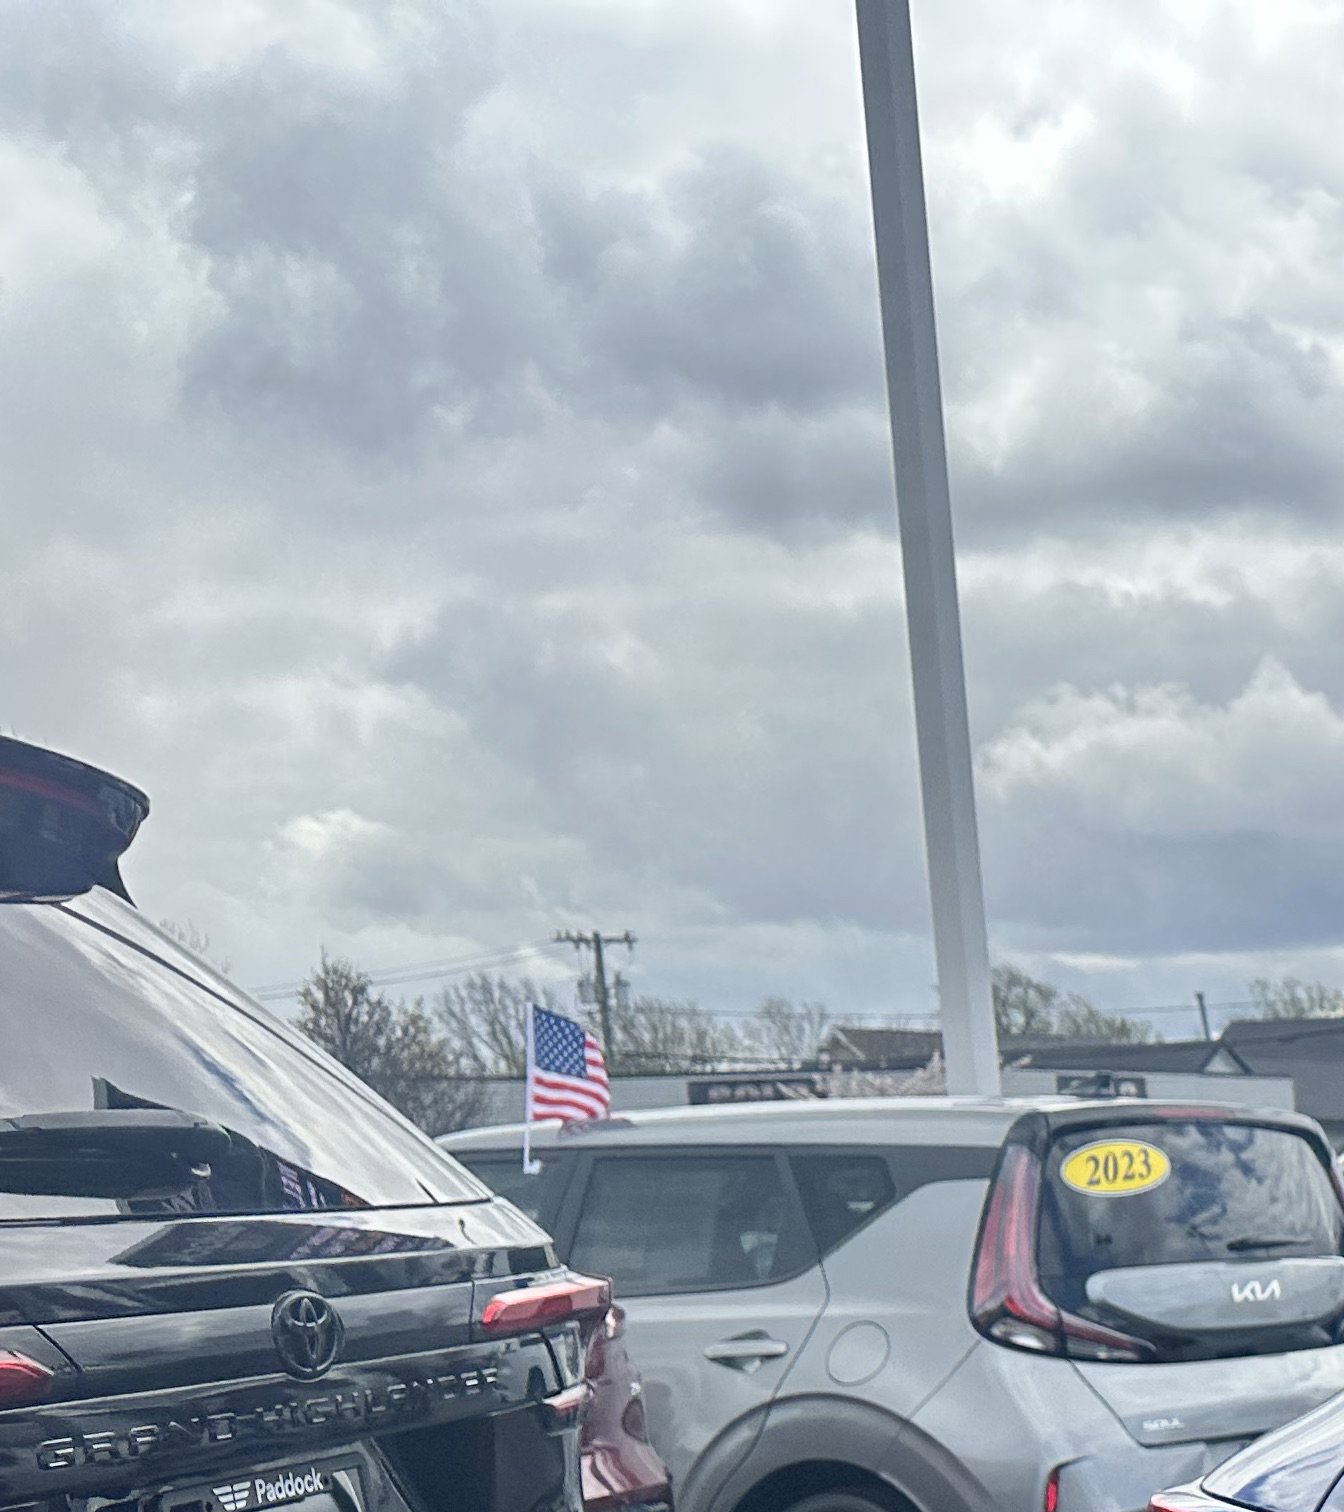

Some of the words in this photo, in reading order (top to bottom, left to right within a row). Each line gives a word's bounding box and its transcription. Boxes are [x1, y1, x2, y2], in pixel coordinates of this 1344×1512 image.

[1085, 1148, 1152, 1186] 2023
[36, 1412, 237, 1470] GRAND
[255, 1467, 324, 1503] Paddock
